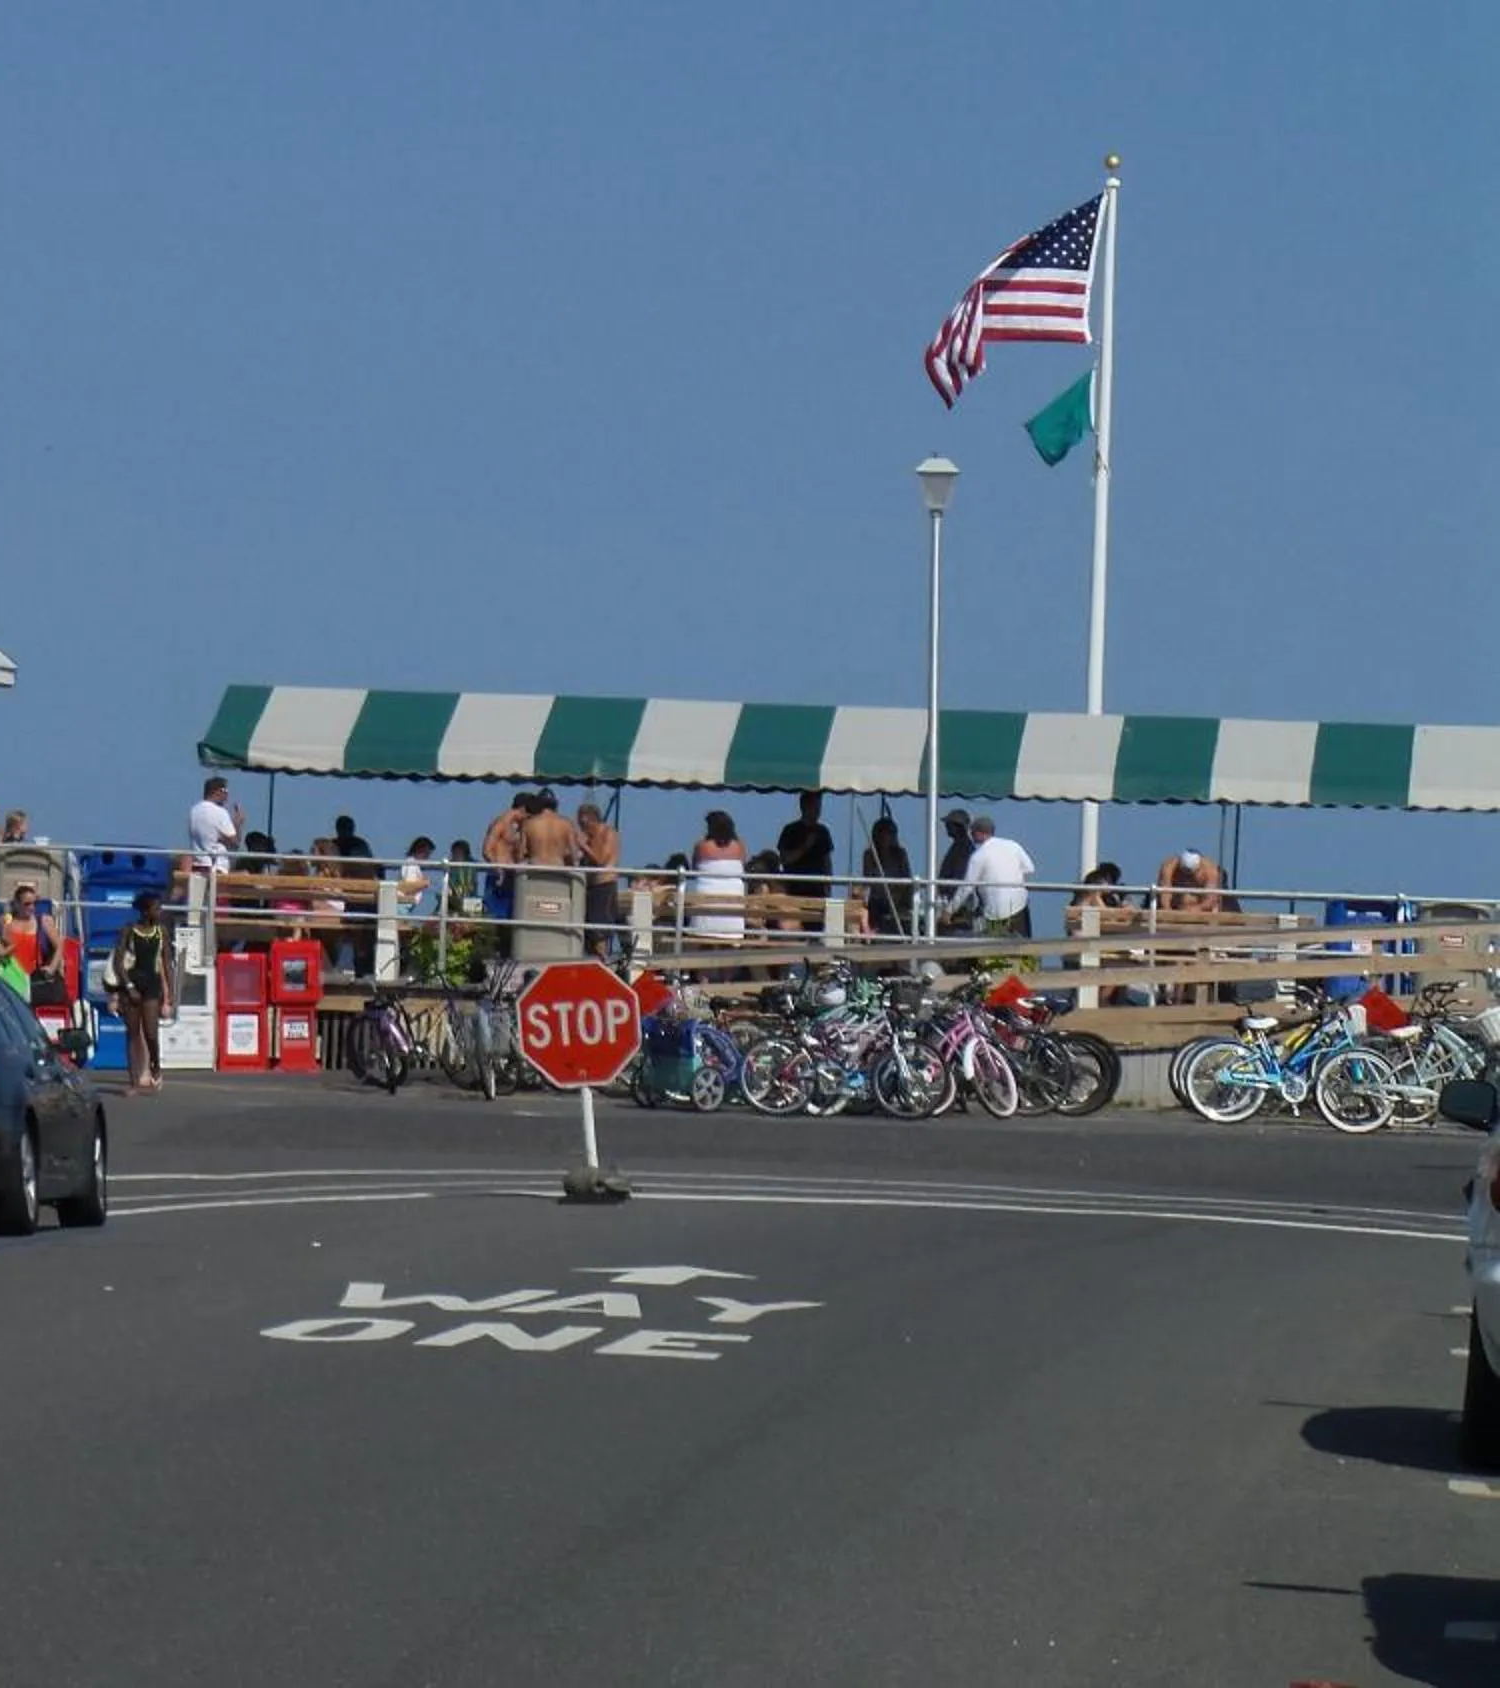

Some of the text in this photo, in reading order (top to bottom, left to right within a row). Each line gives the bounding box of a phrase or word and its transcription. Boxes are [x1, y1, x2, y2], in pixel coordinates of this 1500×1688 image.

[526, 1000, 631, 1049] STOP
[339, 1281, 825, 1323] WAY
[259, 1317, 753, 1360] ONE
